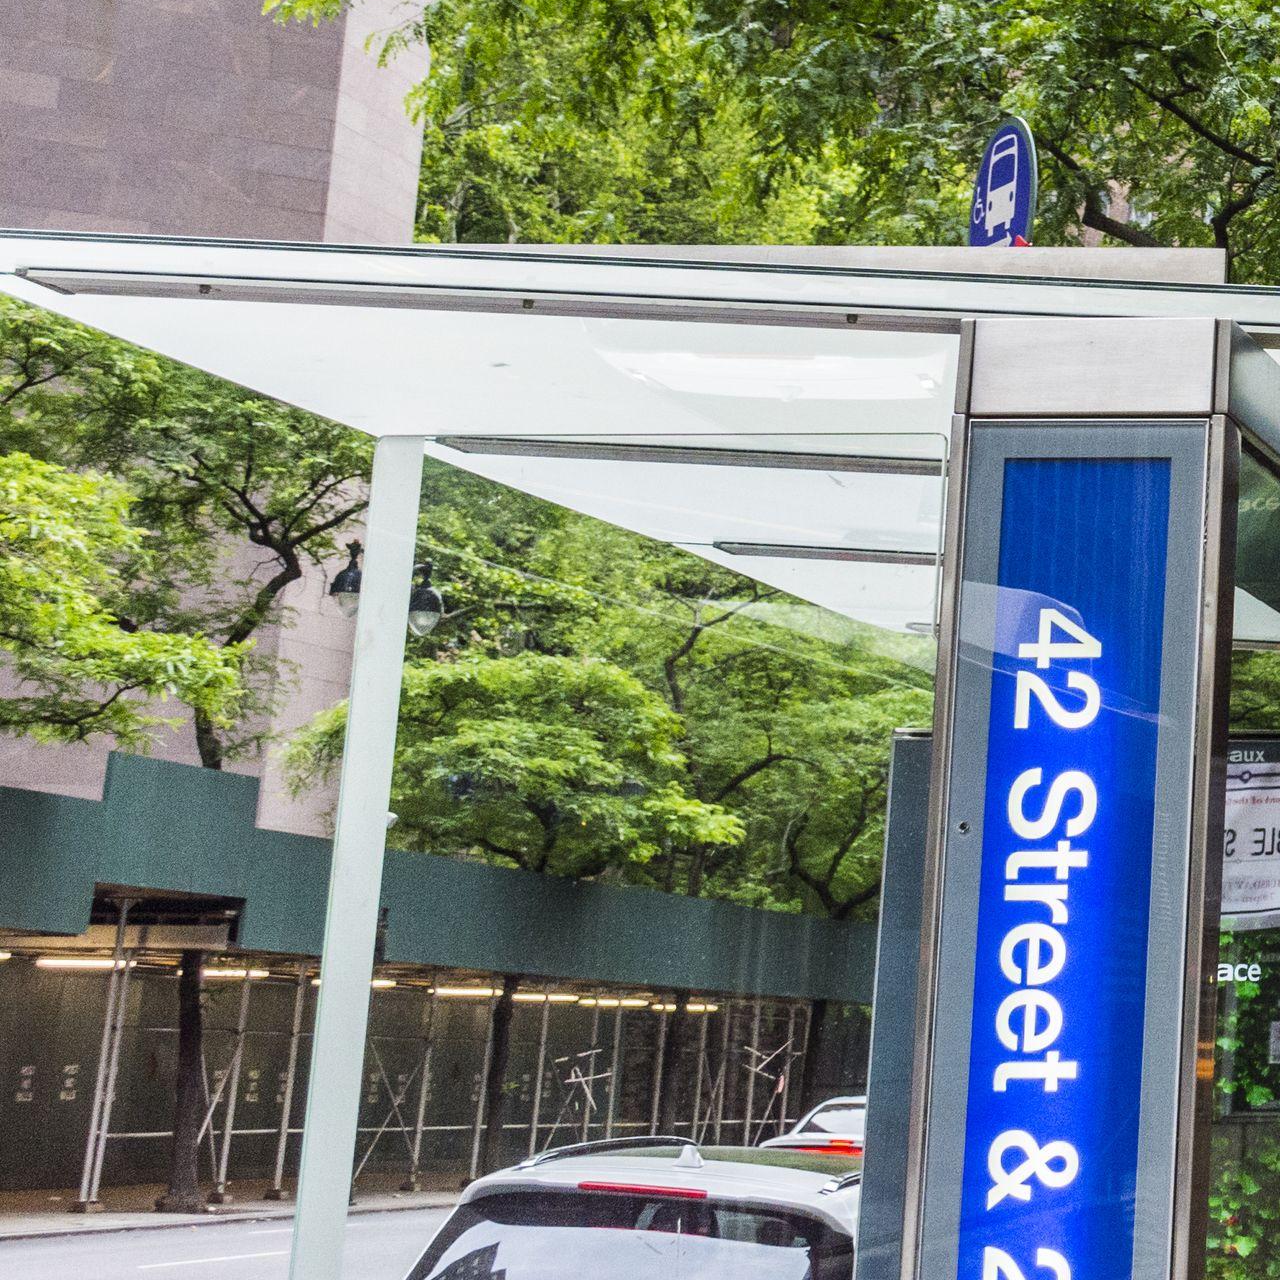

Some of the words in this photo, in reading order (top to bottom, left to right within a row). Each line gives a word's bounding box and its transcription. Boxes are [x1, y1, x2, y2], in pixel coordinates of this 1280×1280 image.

[1014, 608, 1102, 729] 42
[1227, 750, 1265, 762] aux
[993, 766, 1098, 1092] Street
[1217, 963, 1262, 982] ace
[986, 1129, 1080, 1211] &
